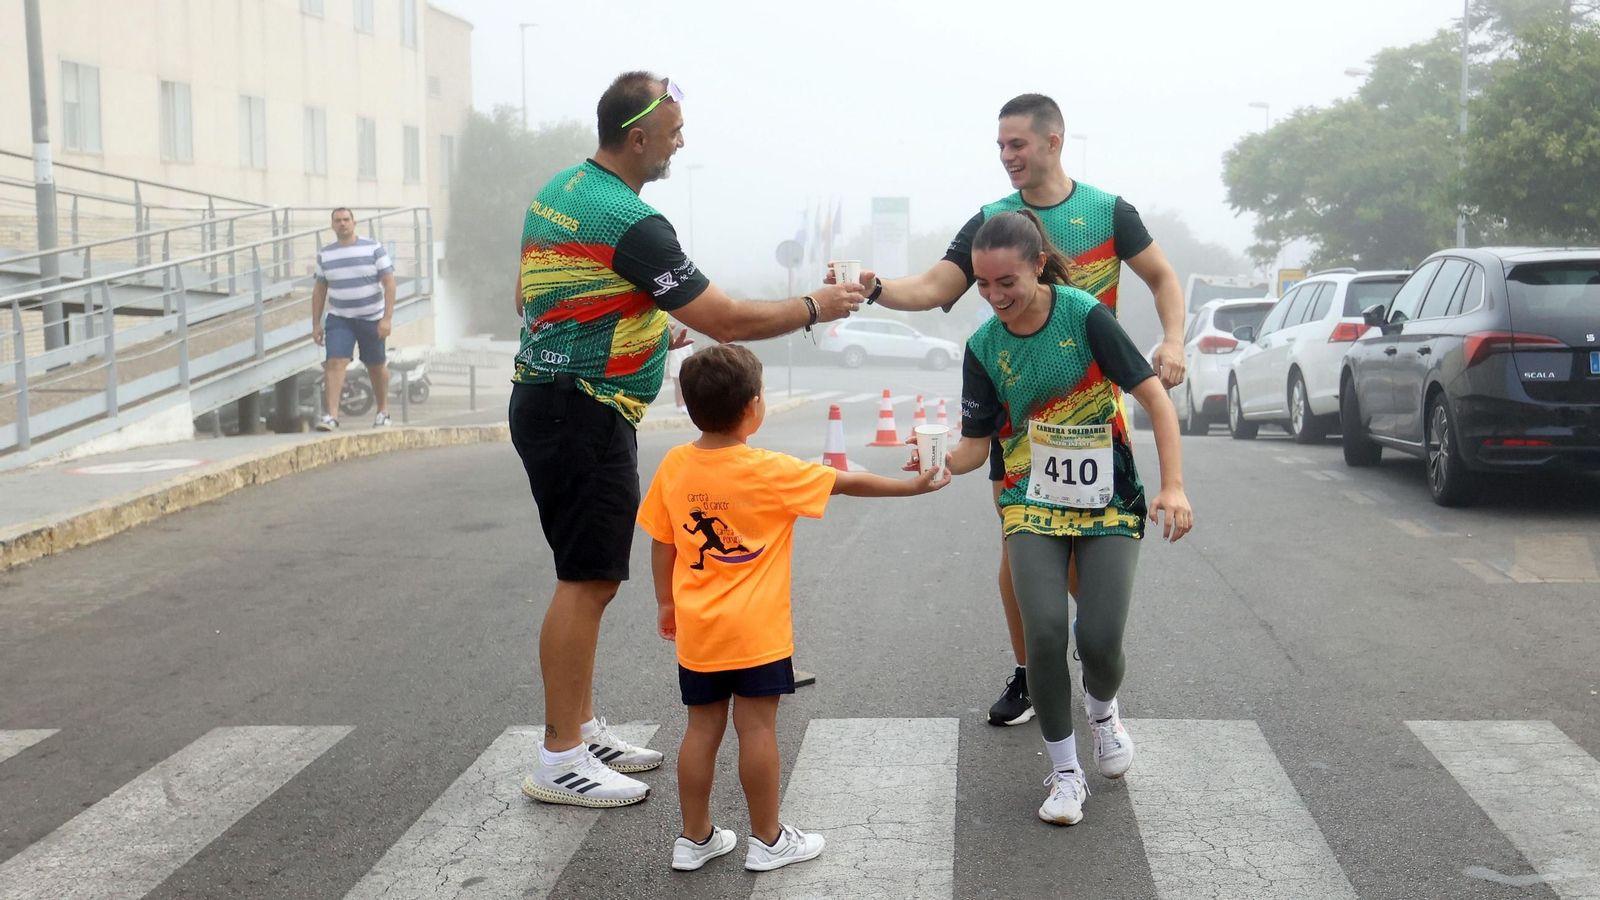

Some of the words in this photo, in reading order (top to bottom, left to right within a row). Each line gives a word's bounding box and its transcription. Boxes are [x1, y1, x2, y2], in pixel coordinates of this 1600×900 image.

[551, 212, 580, 232] 2025
[1036, 424, 1065, 435] CARRERA
[1067, 427, 1106, 435] SOLIDARIA
[1044, 456, 1098, 486] 410
